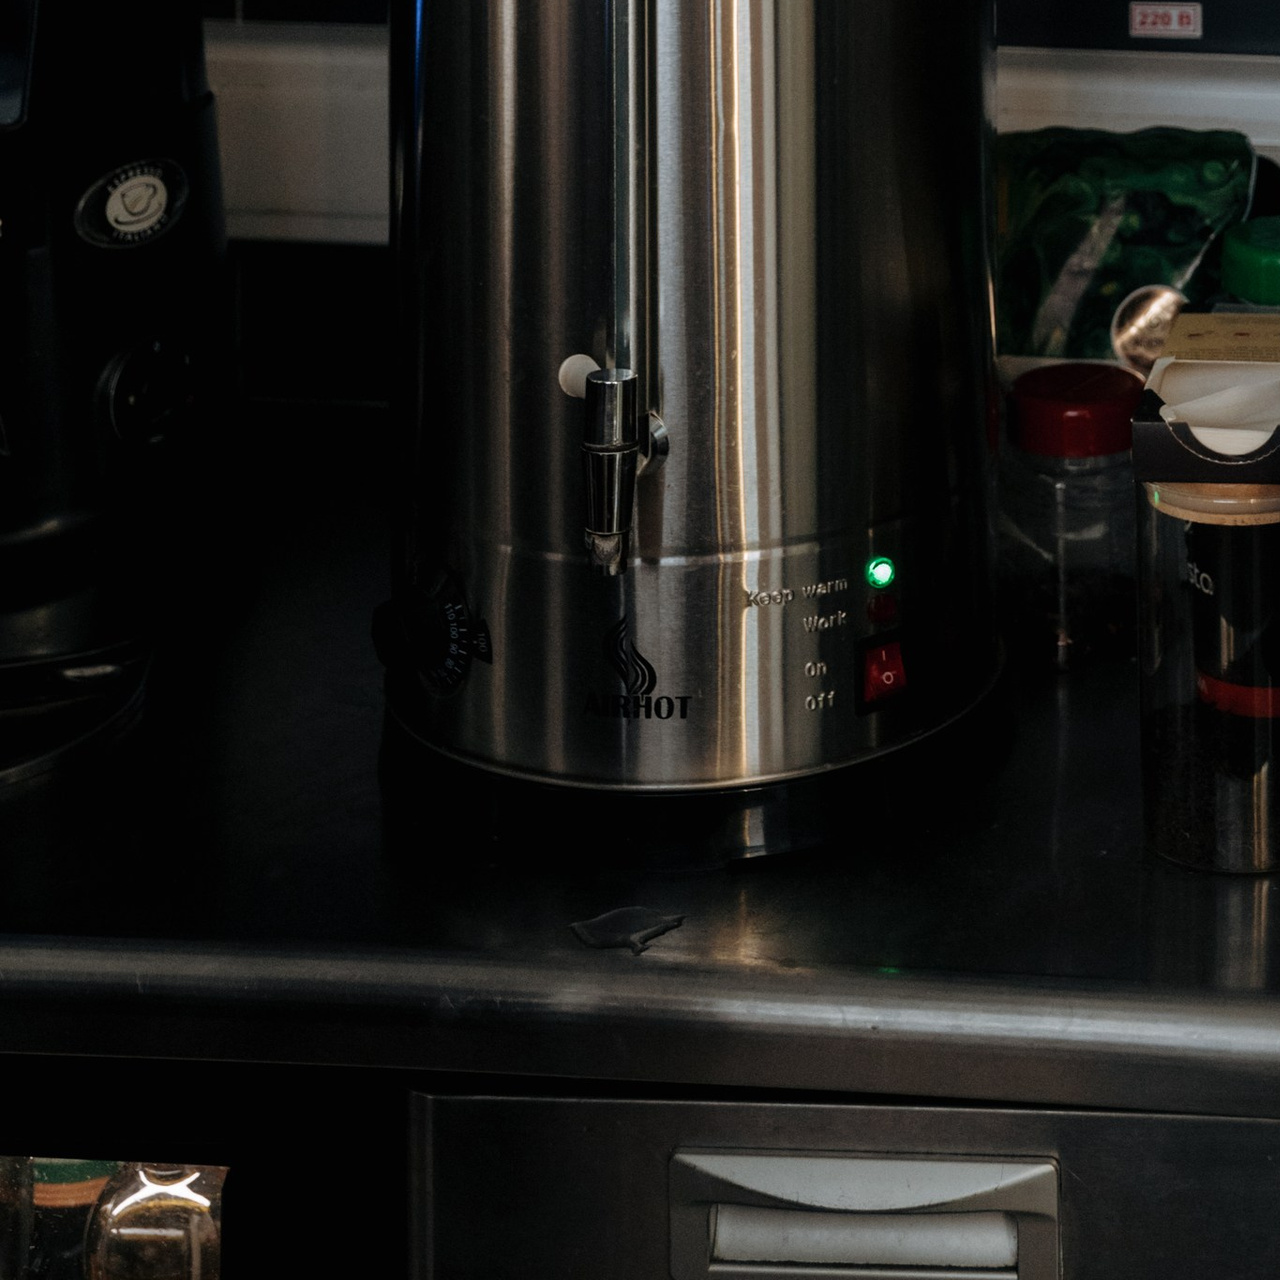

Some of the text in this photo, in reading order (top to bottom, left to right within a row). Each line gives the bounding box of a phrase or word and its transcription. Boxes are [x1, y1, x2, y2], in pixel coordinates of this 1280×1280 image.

[1140, 12, 1172, 26] 220
[747, 578, 848, 608] Keep warm
[449, 622, 459, 639] 100
[803, 610, 848, 633] Work
[477, 632, 488, 653] 100
[804, 661, 827, 678] On
[584, 692, 692, 719] AIRHOT
[805, 690, 835, 710] Off
